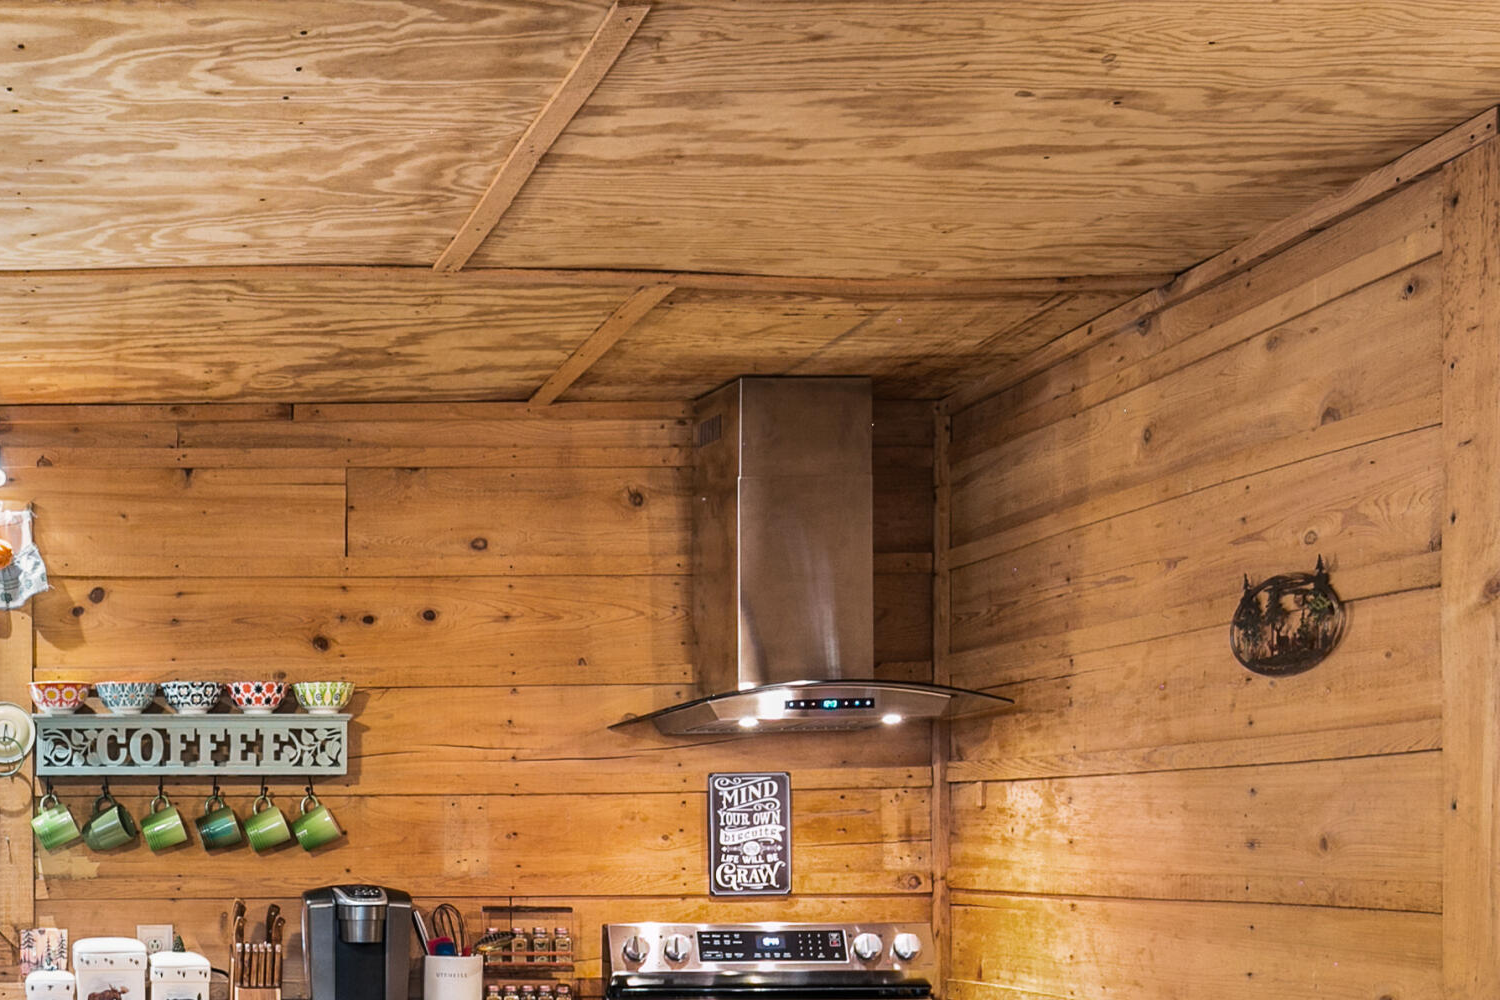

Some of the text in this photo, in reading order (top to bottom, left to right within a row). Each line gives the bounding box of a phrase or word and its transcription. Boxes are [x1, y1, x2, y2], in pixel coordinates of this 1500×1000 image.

[97, 728, 290, 767] COFFEE
[719, 781, 779, 810] MIND
[717, 809, 781, 826] YOUR OWN
[723, 828, 777, 842] biscuits
[721, 853, 779, 864] LIFE WILL BE
[715, 861, 786, 891] GRAVY
